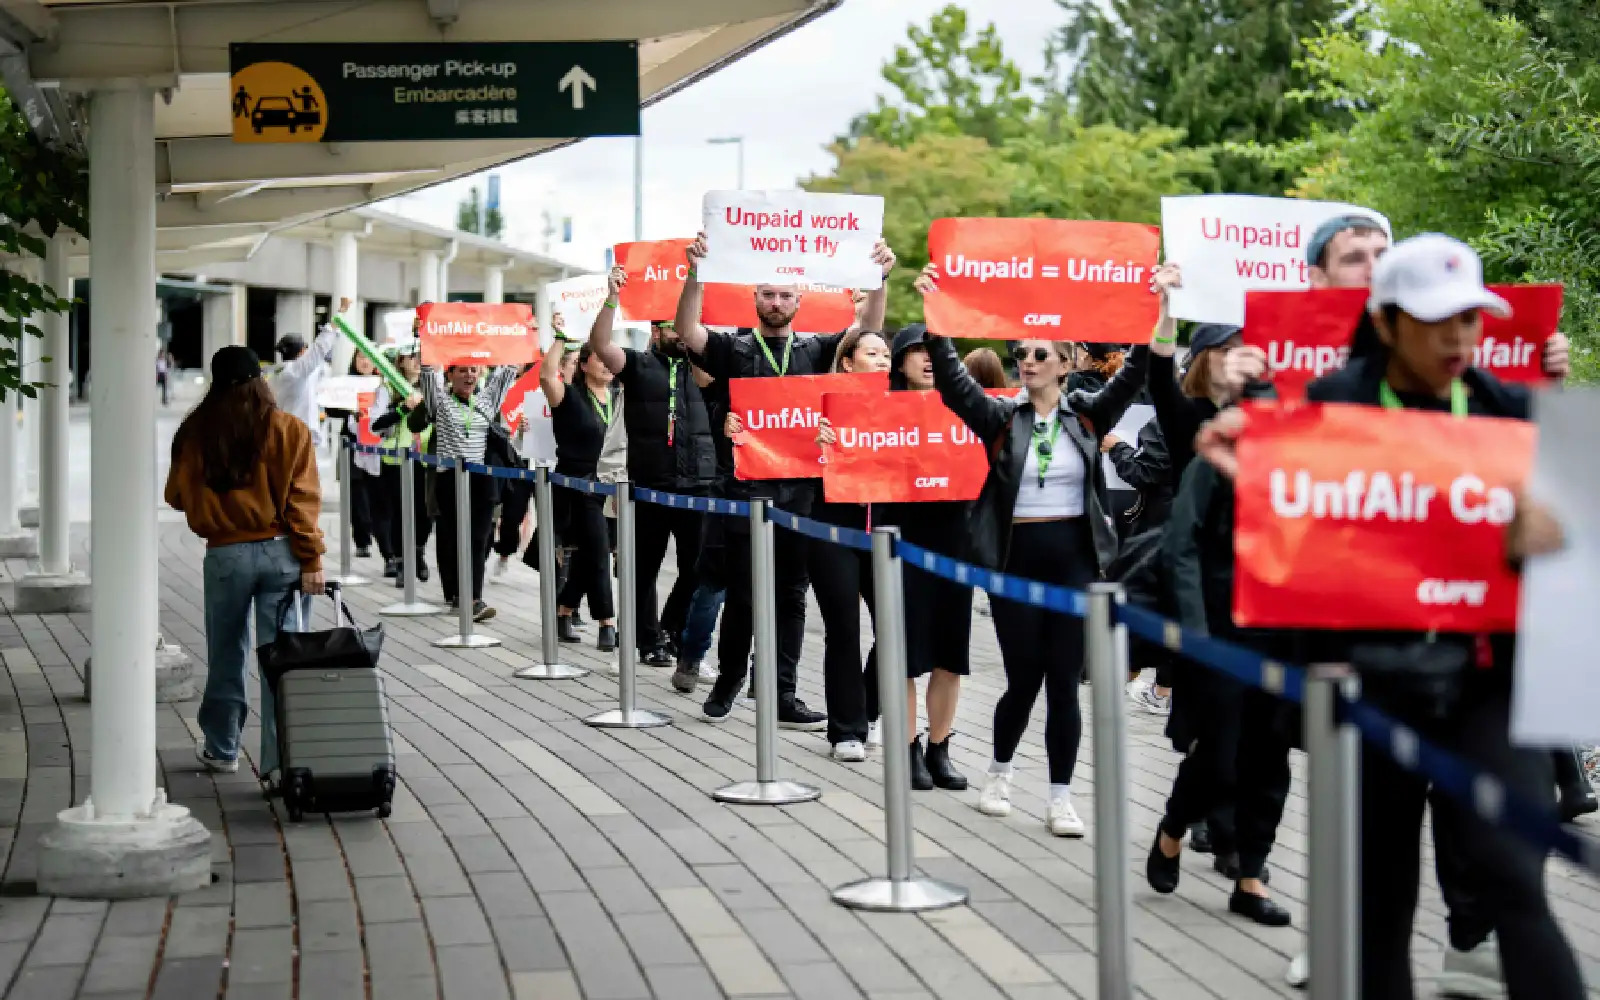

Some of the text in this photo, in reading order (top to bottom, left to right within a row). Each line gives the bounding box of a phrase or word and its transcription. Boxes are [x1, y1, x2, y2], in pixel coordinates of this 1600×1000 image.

[343, 60, 517, 82] Passenger Pick-up
[394, 85, 517, 103] Embarcadère
[726, 207, 860, 231] Unpaid work
[1201, 217, 1300, 250] Unpaid
[750, 235, 840, 257] won't fly
[644, 264, 669, 282] Air
[945, 254, 1145, 284] Unpaid = Unfair
[1235, 257, 1309, 284] won't
[427, 320, 527, 336] UnfAir Canada
[747, 406, 822, 430] UnfAir
[839, 427, 920, 452] Unpaid
[927, 432, 943, 444] =
[1268, 467, 1437, 521] UnfAir
